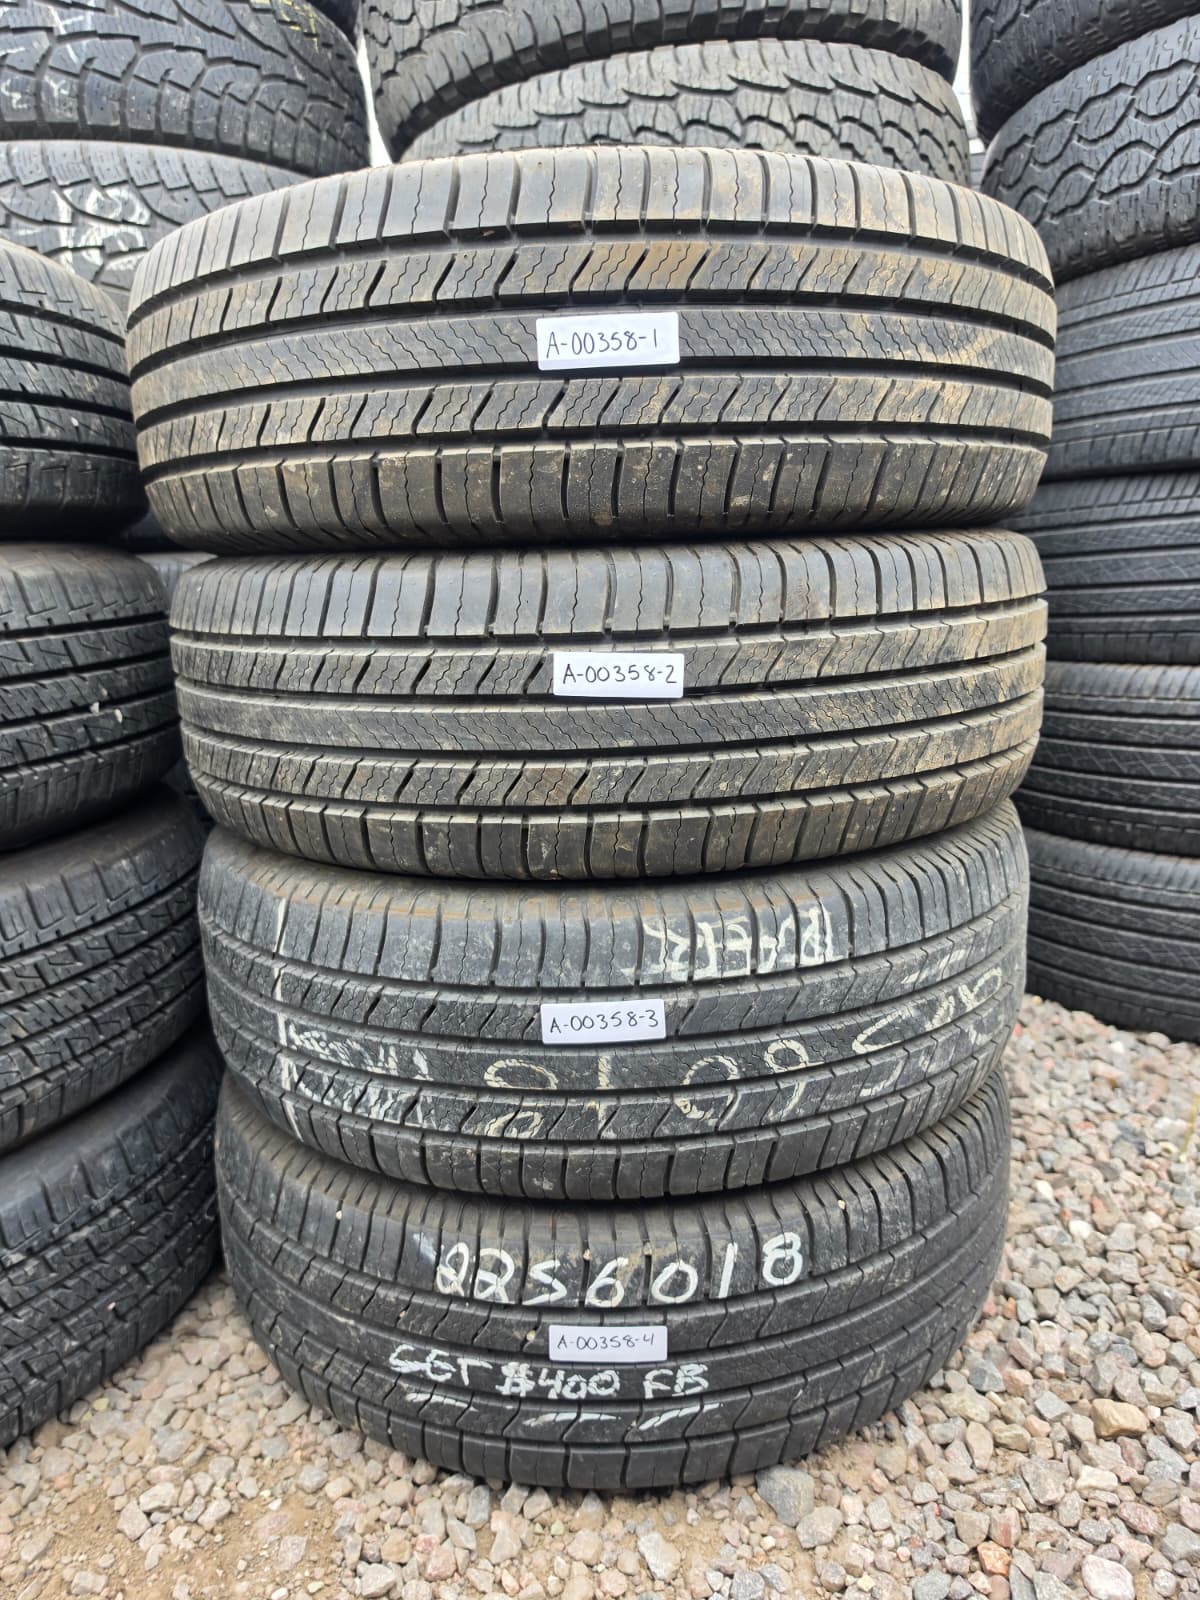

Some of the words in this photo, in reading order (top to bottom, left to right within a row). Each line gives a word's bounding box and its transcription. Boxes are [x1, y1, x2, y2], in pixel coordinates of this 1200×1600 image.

[546, 327, 658, 359] A-00358-1
[562, 663, 678, 685] A-00358-2
[550, 1009, 659, 1034] A-00358-3
[557, 1332, 655, 1351] A-00358-4
[388, 1344, 493, 1383] SET
